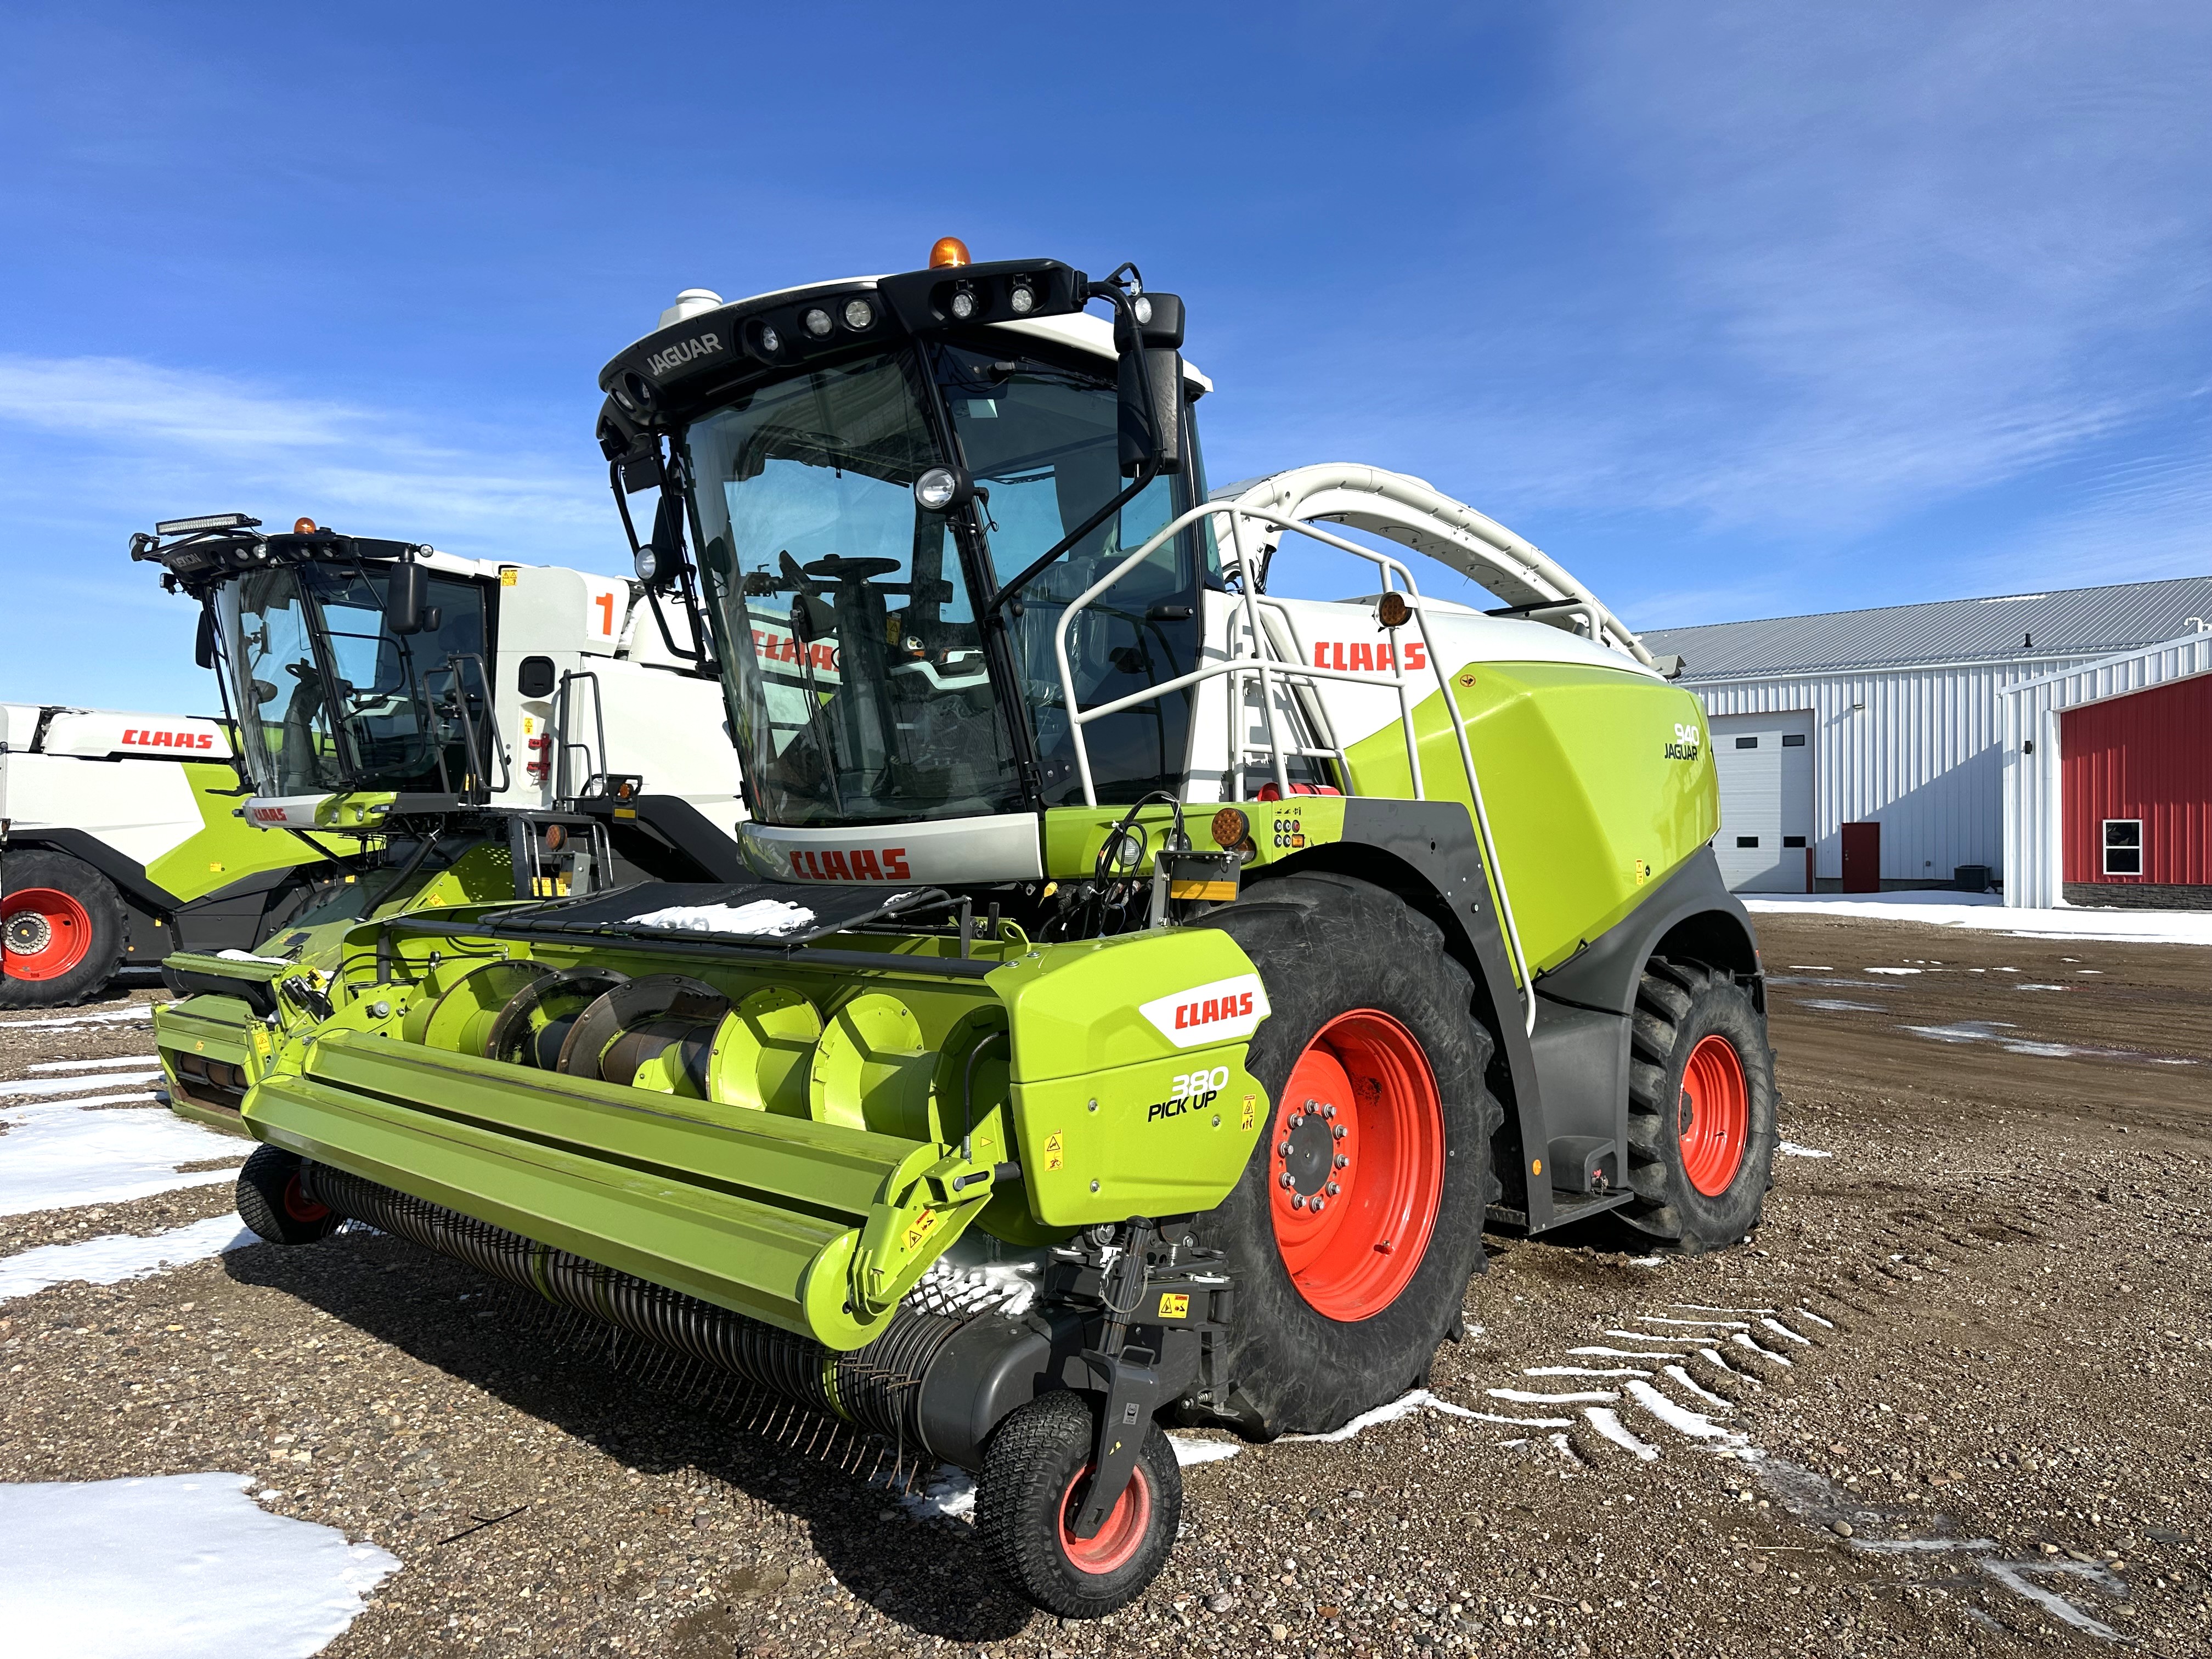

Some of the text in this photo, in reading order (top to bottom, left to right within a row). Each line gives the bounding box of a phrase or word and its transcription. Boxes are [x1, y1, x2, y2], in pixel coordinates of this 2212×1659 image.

[646, 332, 723, 377] JAGUAR
[596, 592, 613, 635] 1
[751, 629, 840, 673] CLAA
[1314, 641, 1425, 671] CLAAS
[122, 729, 213, 748] CLAAS
[1674, 723, 1700, 747] 940
[1664, 742, 1699, 761] JAGUAR
[253, 808, 287, 821] CLAAS
[790, 848, 911, 881] CLAAS
[1175, 991, 1253, 1030] CLAAS
[1170, 1065, 1228, 1102] 380
[1148, 1090, 1217, 1122] PICK UP
